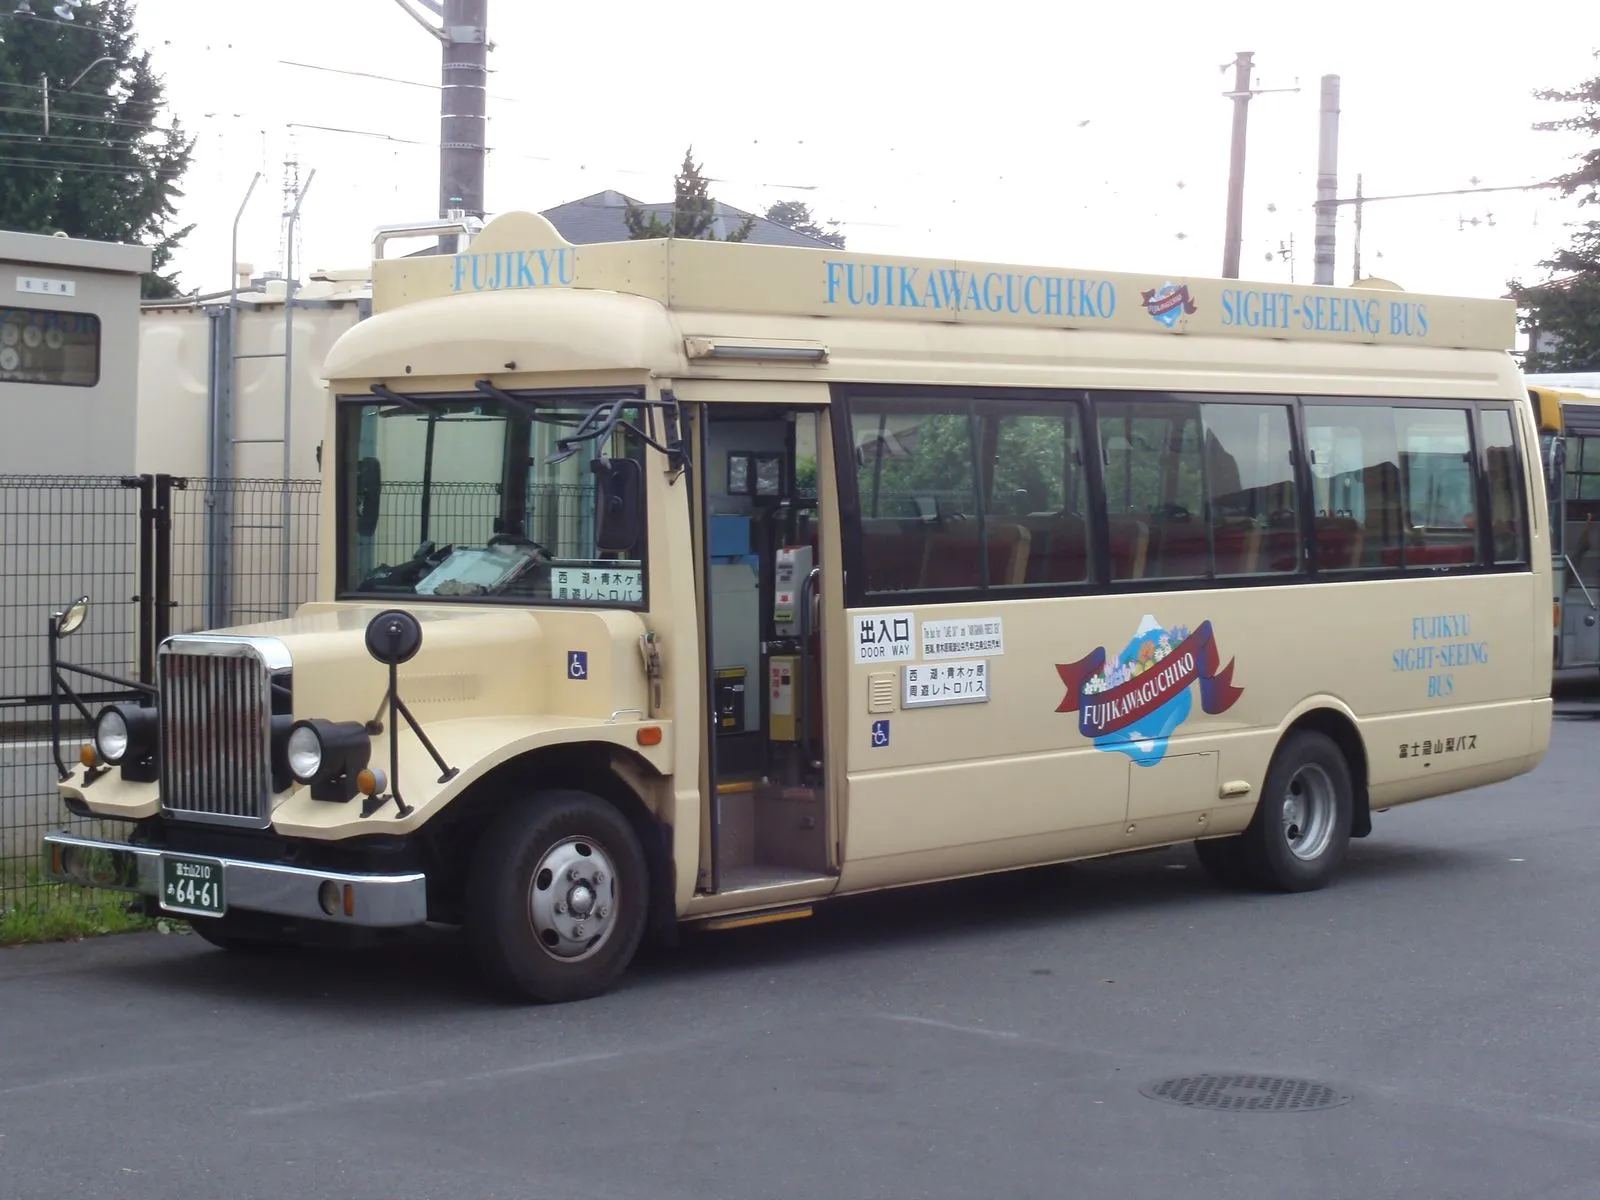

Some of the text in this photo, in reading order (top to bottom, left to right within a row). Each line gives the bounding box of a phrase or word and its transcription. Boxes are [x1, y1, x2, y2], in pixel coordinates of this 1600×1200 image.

[453, 247, 575, 291] FUJIKYU
[826, 261, 1116, 319] FUJIKAWAGUCHIKO
[1221, 289, 1381, 334] SIGHT-SEEING
[1388, 302, 1428, 337] BUS
[860, 618, 909, 643] 出入口
[1412, 614, 1470, 640] FUJIKYU
[861, 646, 885, 658] DOOR
[892, 644, 910, 656] WAY
[1392, 641, 1489, 671] SIGHT-SEEING
[1083, 652, 1194, 730] FUJIKAWAGUCHIKO
[1427, 674, 1454, 698] BUS
[1399, 735, 1477, 759] 富士急山梨バス
[176, 878, 219, 908] 64-61
